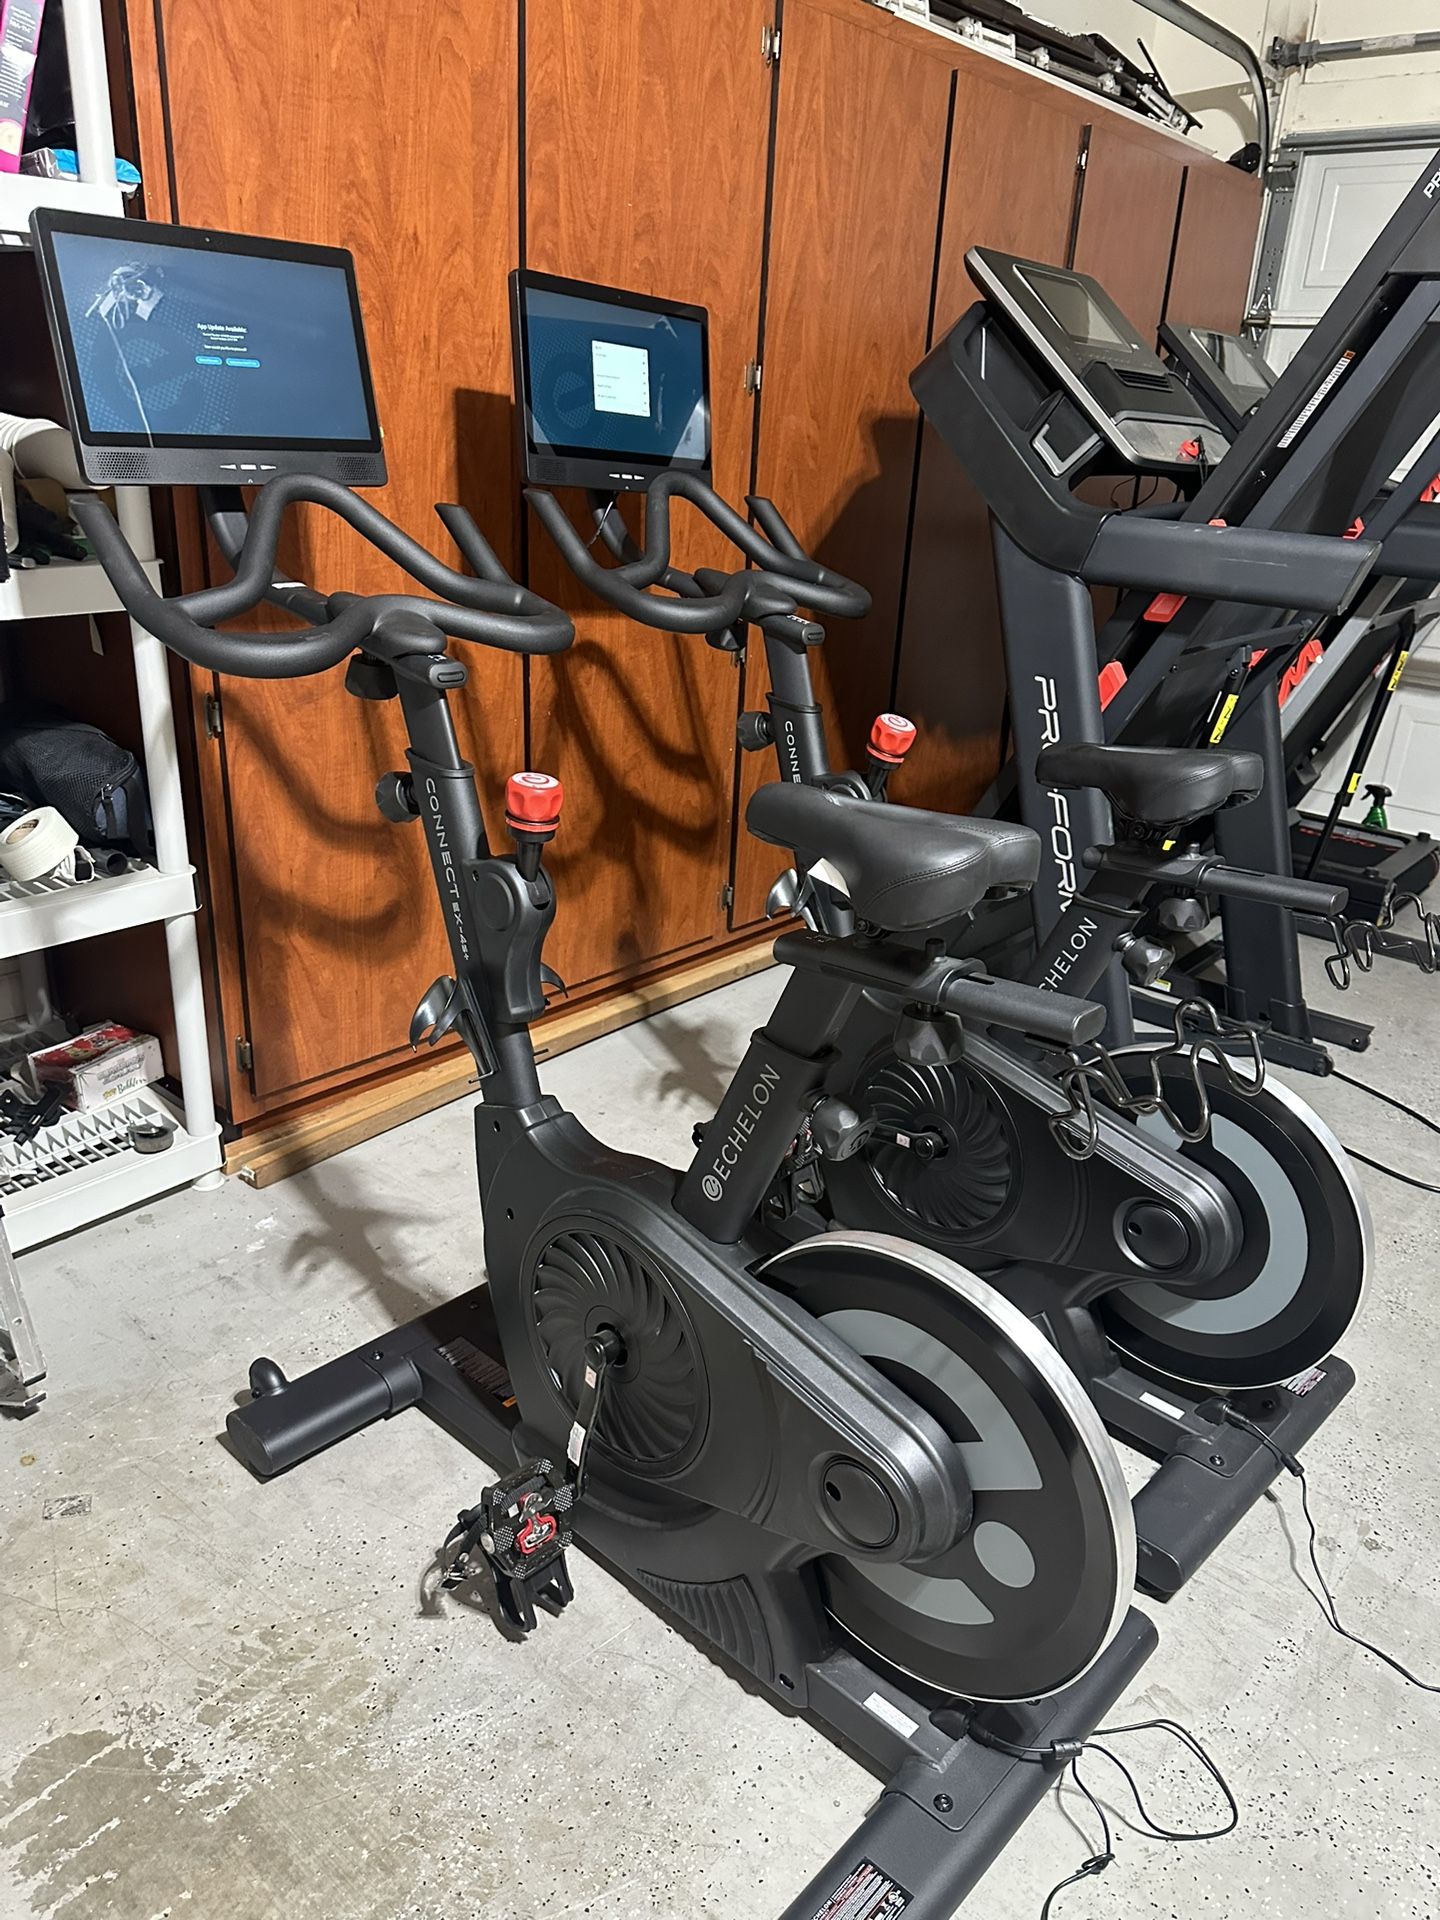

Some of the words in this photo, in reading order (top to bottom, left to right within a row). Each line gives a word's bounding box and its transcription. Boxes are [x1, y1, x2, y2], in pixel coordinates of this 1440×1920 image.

[1423, 168, 1440, 199] PR
[784, 720, 802, 784] CONNE
[425, 777, 460, 899] CONNECT
[1038, 916, 1098, 993] HELON
[712, 1063, 781, 1181] ECHELON
[811, 1899, 832, 1920] CHELON
